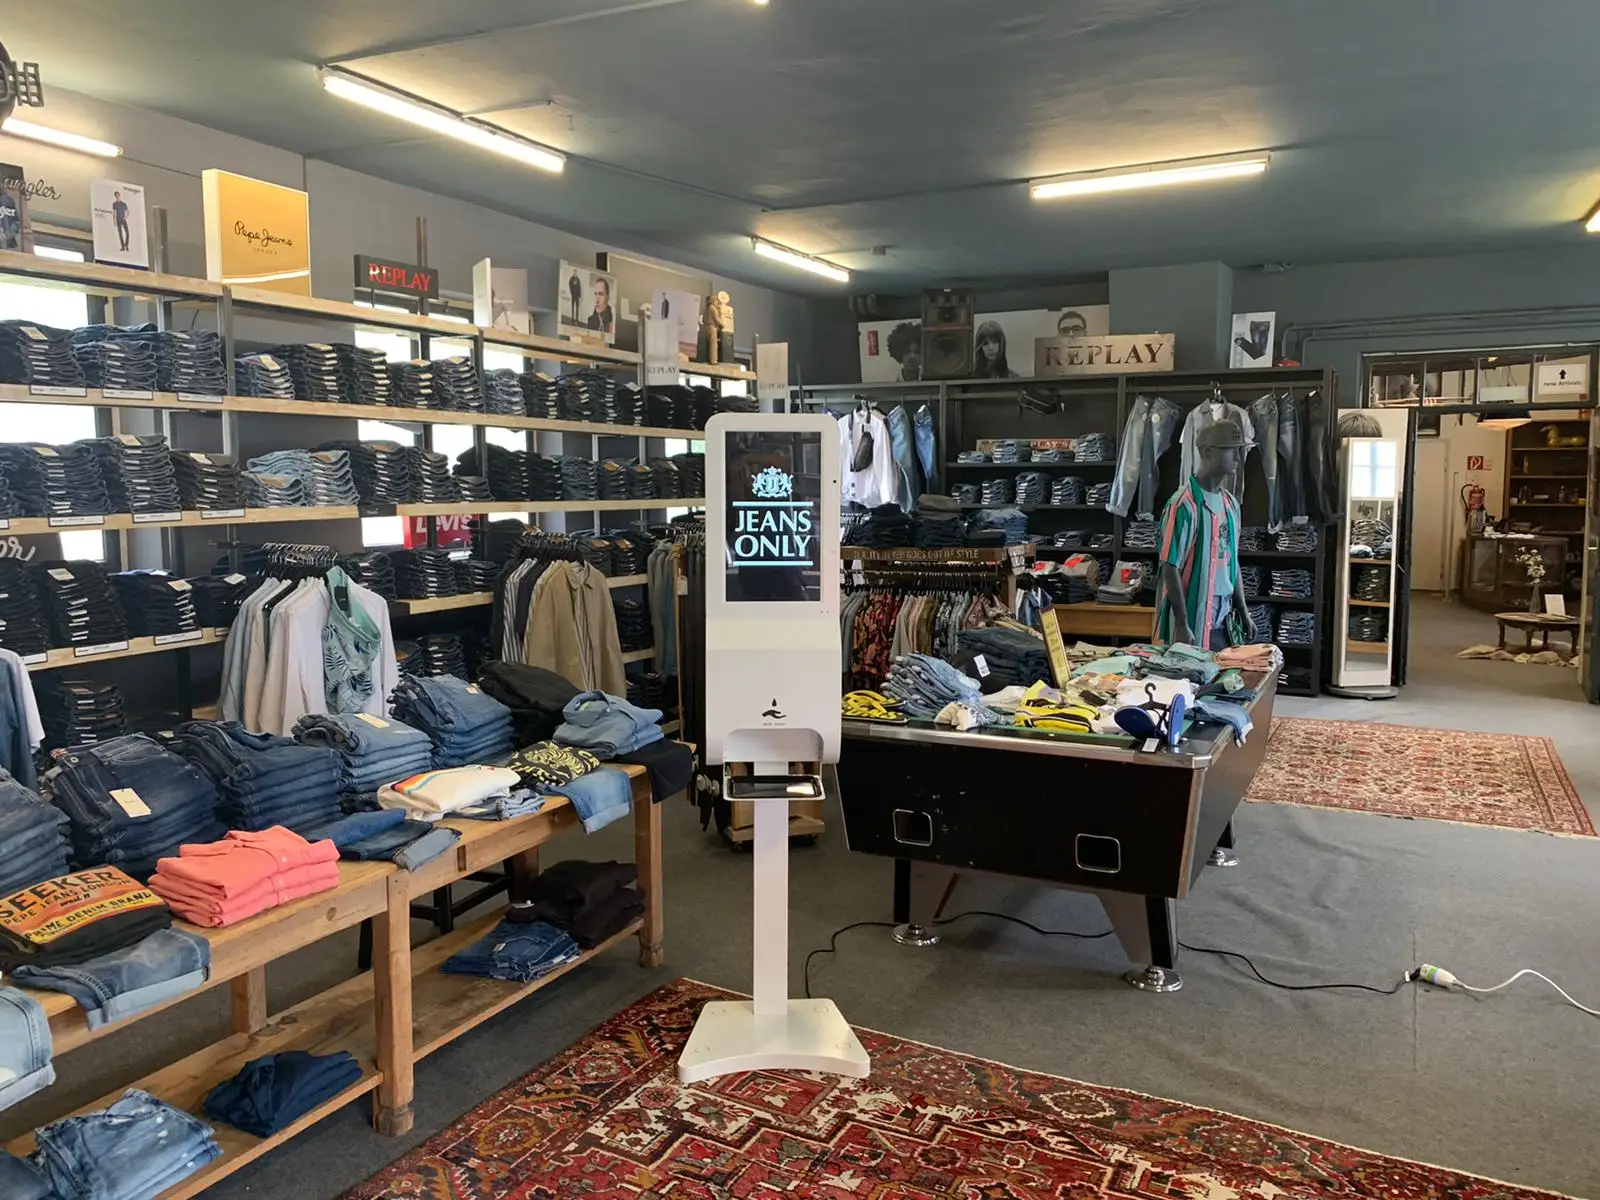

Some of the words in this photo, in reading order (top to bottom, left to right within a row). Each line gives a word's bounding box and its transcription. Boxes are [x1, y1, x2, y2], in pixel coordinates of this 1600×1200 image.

[234, 220, 260, 244] Pepe
[261, 228, 293, 247] Jeans
[367, 263, 431, 292] REPLAY
[1043, 343, 1164, 367] REPLAY
[735, 510, 811, 532] JEANS
[735, 534, 811, 557] ONLY
[956, 549, 979, 559] STYLE
[4, 909, 38, 925] PEPE
[40, 887, 77, 908] JEANS
[24, 920, 64, 940] PRIME
[67, 903, 109, 922] DENIM
[110, 891, 152, 907] BRAND
